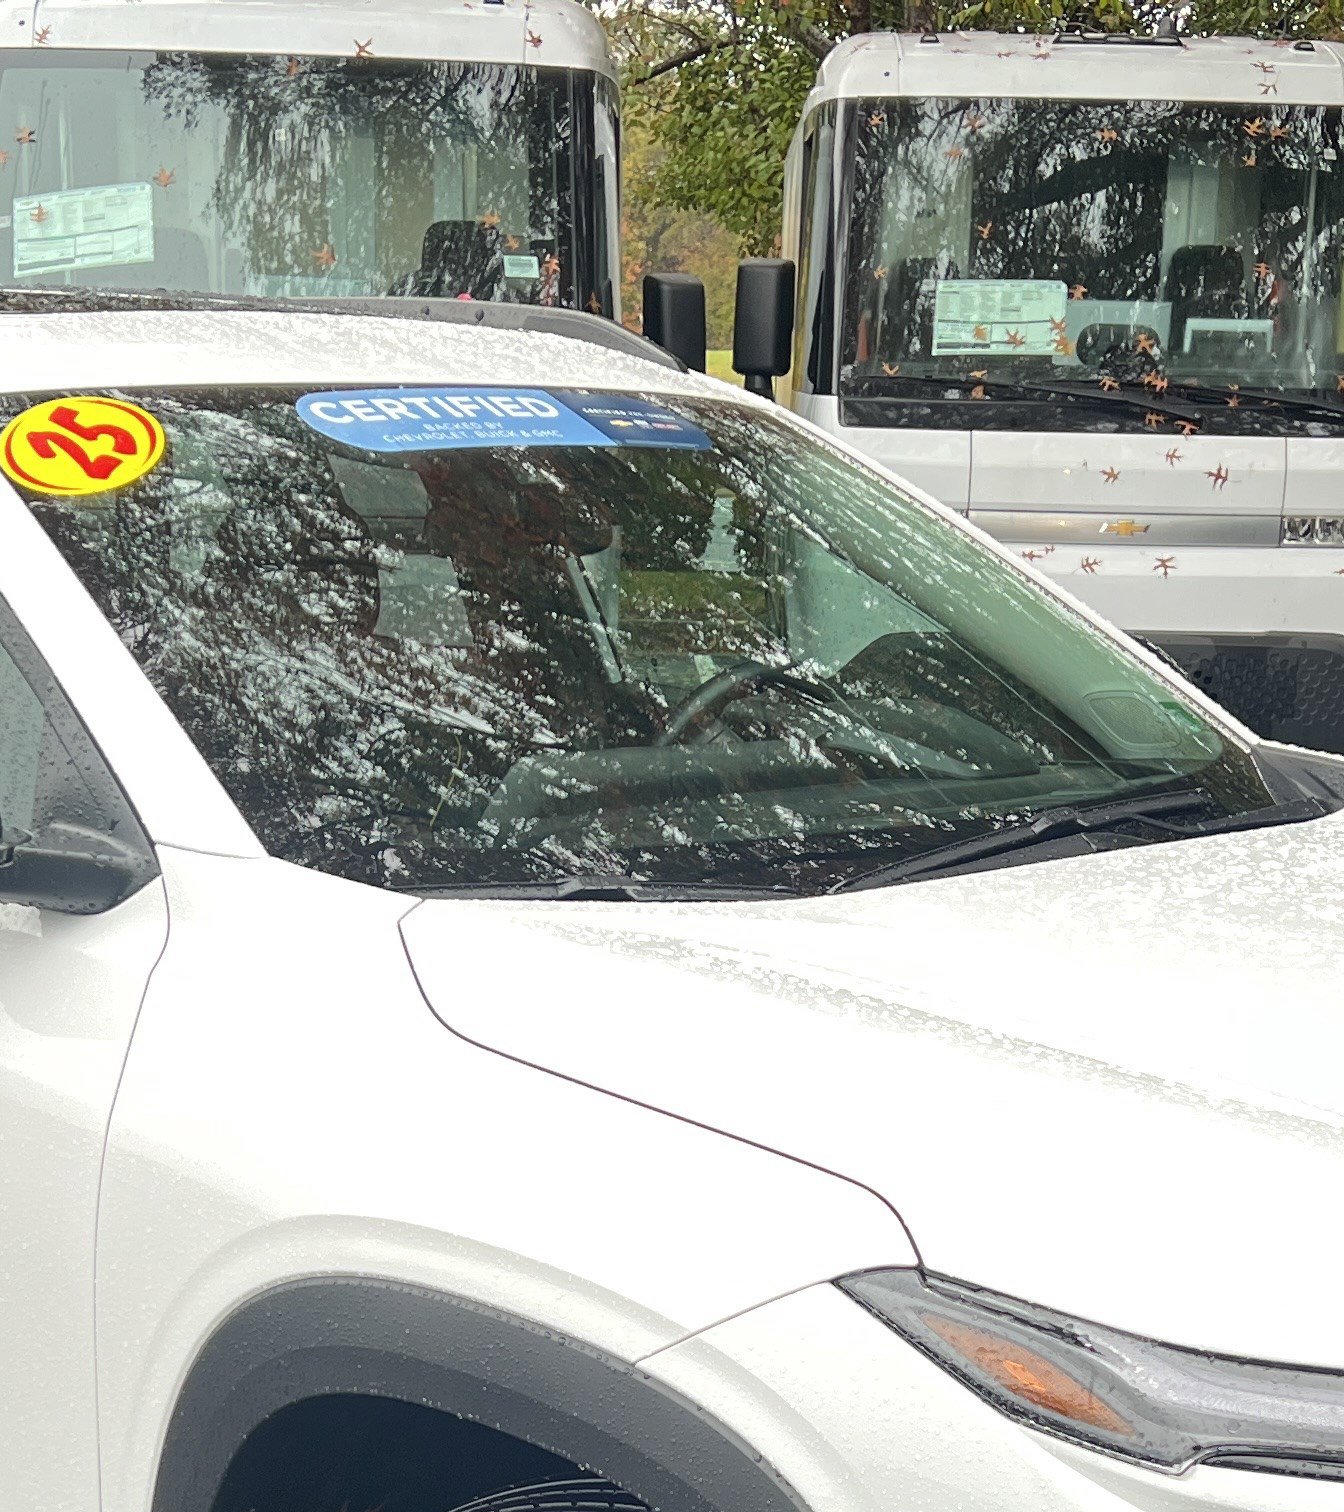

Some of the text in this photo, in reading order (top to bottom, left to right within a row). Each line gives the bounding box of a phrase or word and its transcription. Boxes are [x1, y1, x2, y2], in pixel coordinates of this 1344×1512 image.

[309, 396, 561, 424] CERTIFIED
[422, 421, 504, 432] BACKED BY
[477, 429, 522, 440] BUICK
[532, 429, 564, 439] GMC
[26, 406, 138, 480] 25
